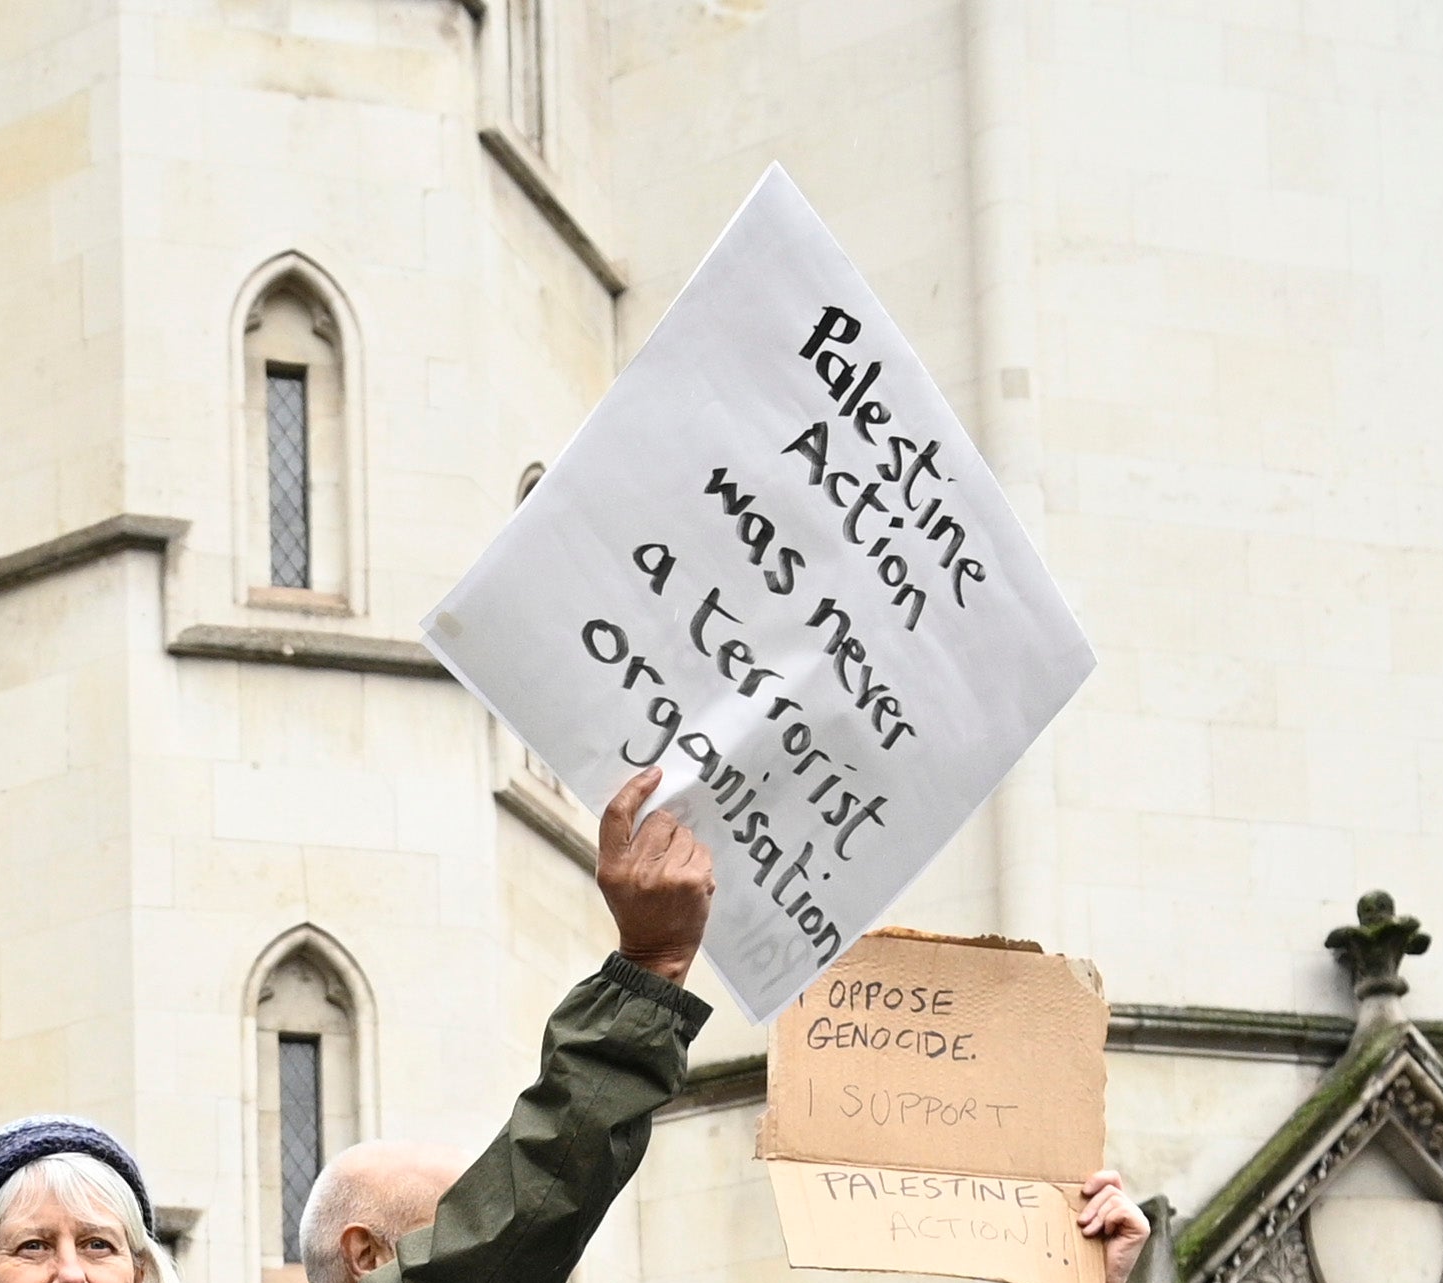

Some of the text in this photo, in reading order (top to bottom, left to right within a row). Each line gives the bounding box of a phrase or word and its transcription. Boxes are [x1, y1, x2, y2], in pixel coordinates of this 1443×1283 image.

[781, 421, 927, 631] Action
[800, 305, 986, 608] Palestine
[632, 542, 676, 595] a
[689, 587, 885, 861] terrorist
[704, 467, 916, 750] was never
[582, 618, 842, 966] organisation
[806, 1017, 976, 1061] GENOCIDE.
[828, 980, 954, 1015] OPPOSE
[808, 1078, 1018, 1128] I SUPPORT
[817, 1172, 1040, 1209] PALESTINE
